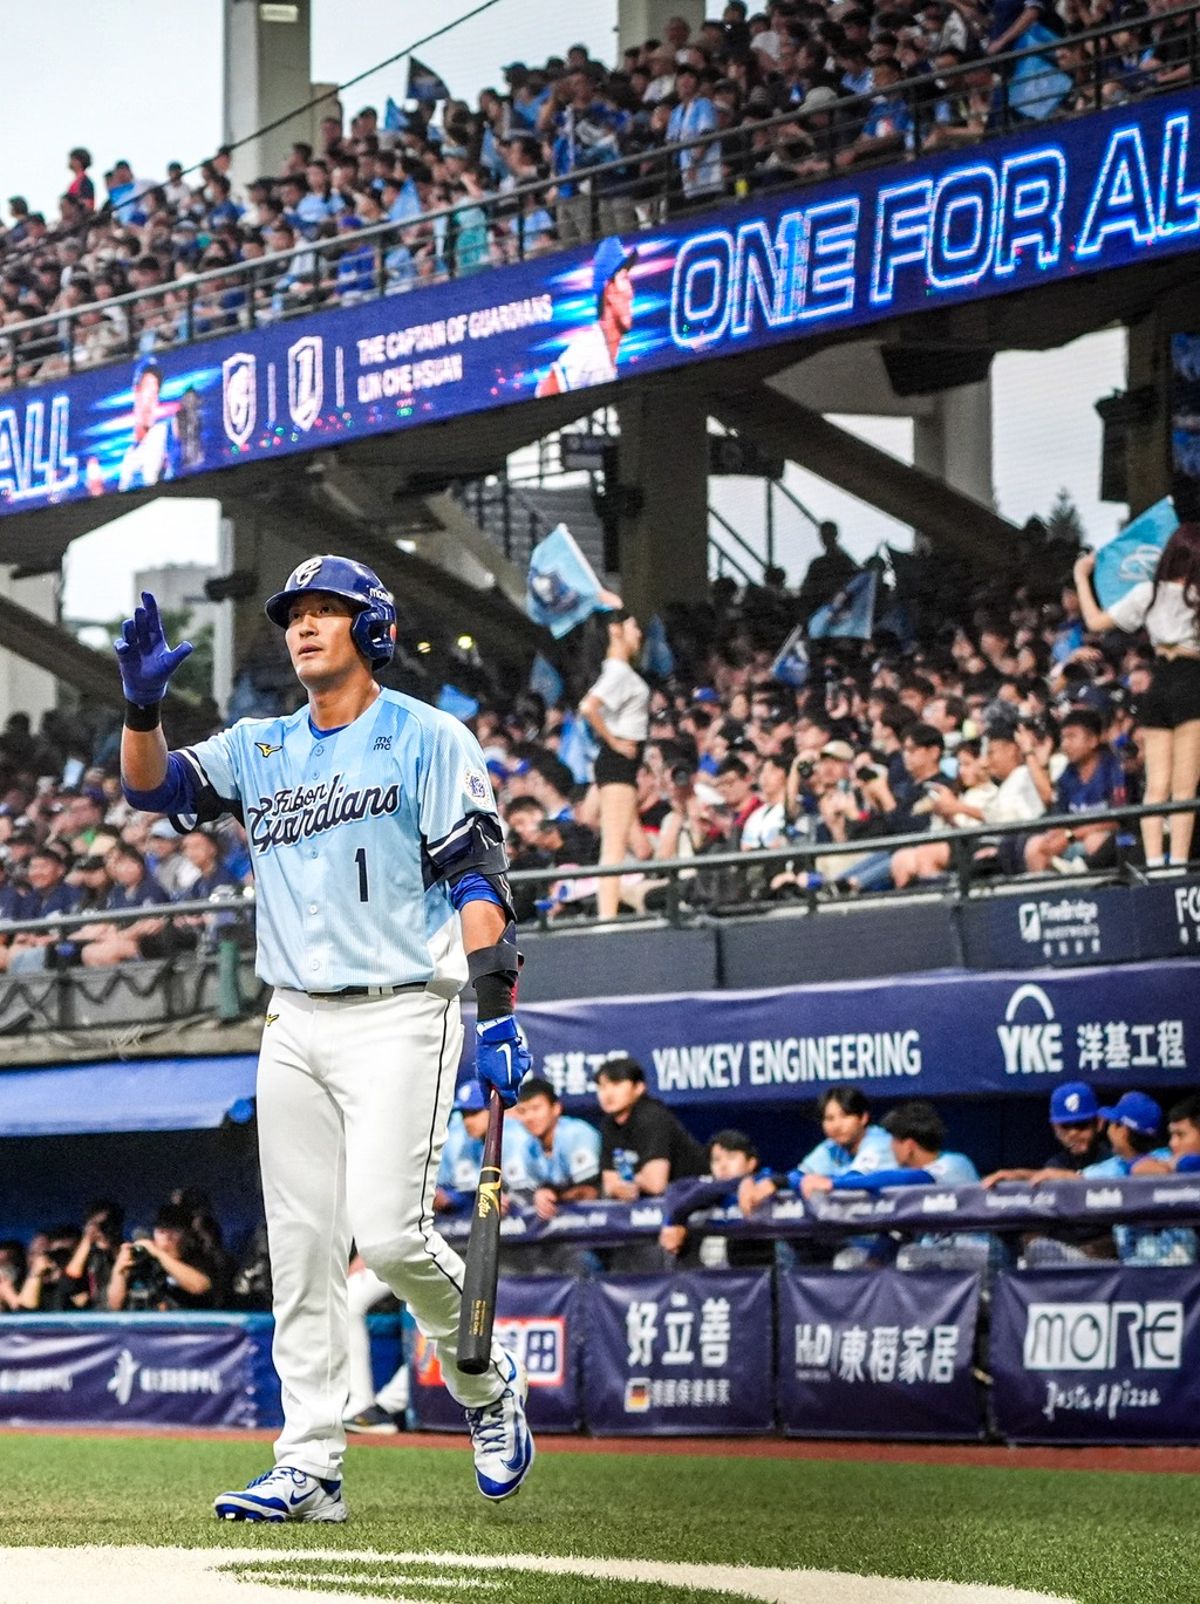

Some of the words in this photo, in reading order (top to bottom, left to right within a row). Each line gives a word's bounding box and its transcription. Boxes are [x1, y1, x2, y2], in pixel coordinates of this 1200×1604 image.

[670, 199, 859, 348] ONE
[871, 148, 1065, 302] FOR
[357, 335, 386, 366] THE
[446, 314, 468, 345] OF
[248, 773, 402, 855] Guardians
[271, 781, 328, 817] Fubon
[354, 847, 369, 903] 1
[543, 1050, 629, 1096] 洋基工
[652, 1042, 744, 1091] YANKEY
[748, 1030, 921, 1085] ENGINEERING
[997, 1022, 1064, 1074] YKE
[1076, 1020, 1187, 1071] 洋基工程
[625, 1291, 731, 1367] 好立善
[838, 1324, 960, 1384] 東稻家居
